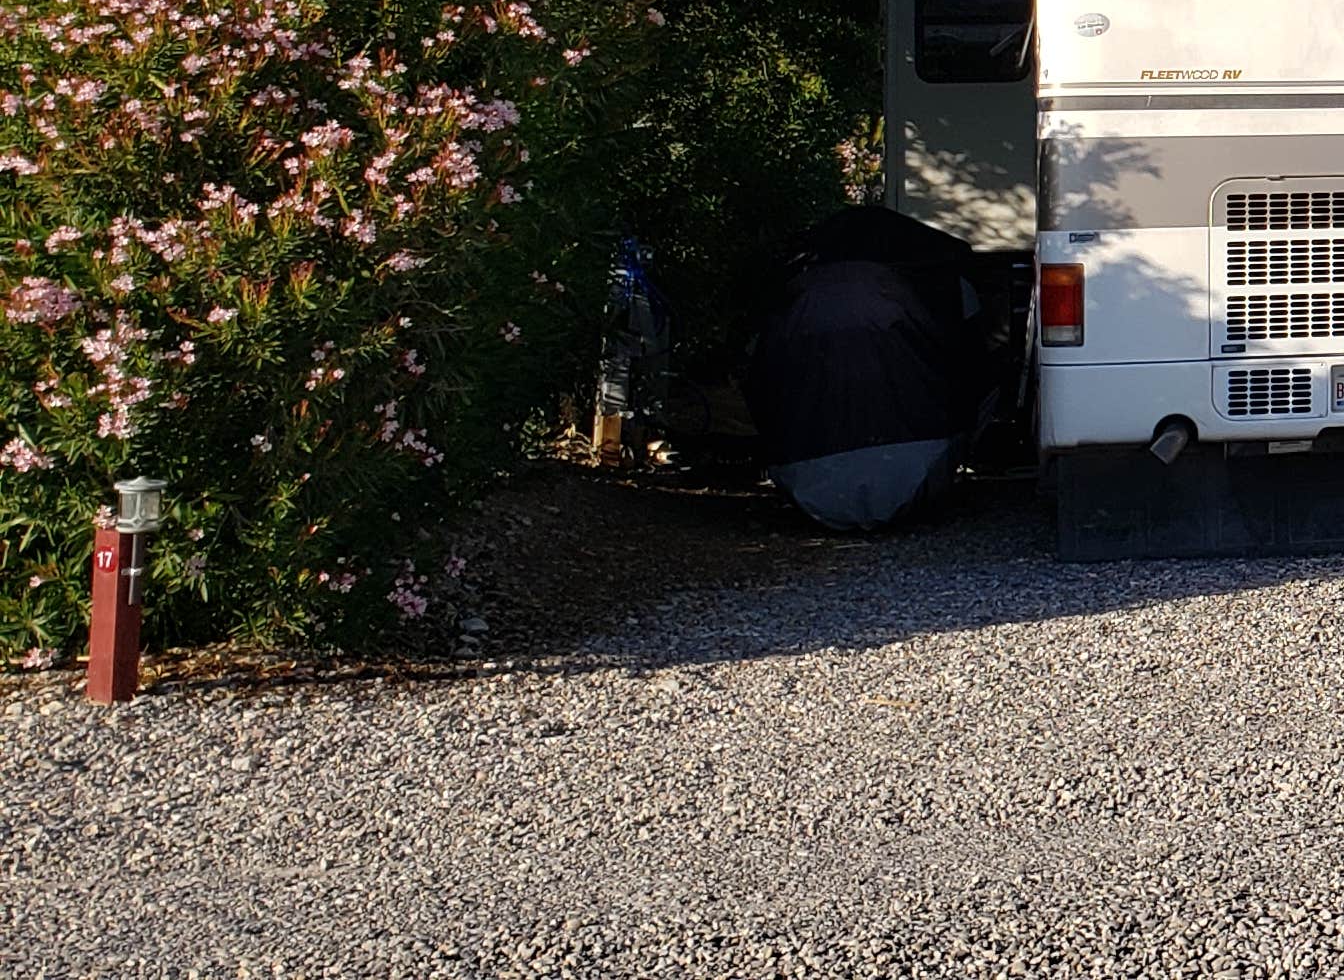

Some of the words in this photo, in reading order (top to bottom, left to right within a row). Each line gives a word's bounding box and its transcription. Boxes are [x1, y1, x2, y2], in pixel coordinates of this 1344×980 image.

[1140, 69, 1218, 80] FLEETWOOD
[1222, 69, 1242, 80] RV
[97, 551, 113, 568] 17
